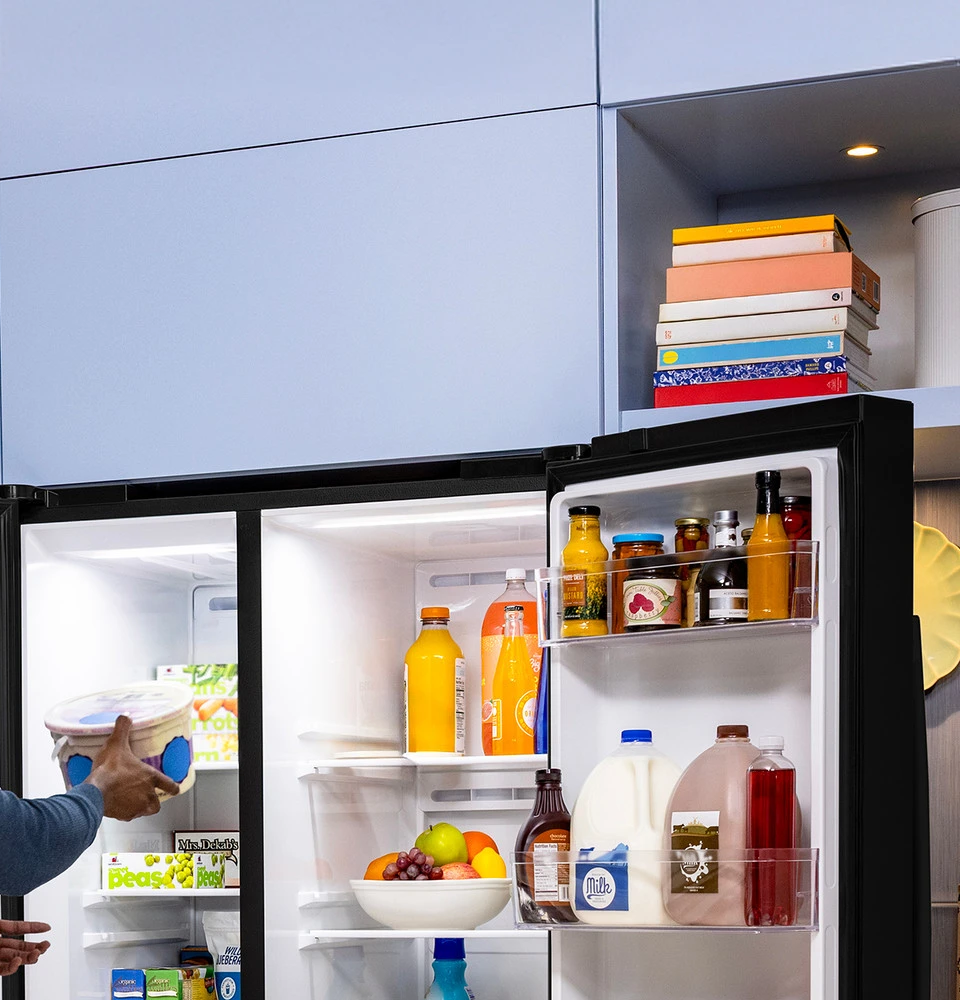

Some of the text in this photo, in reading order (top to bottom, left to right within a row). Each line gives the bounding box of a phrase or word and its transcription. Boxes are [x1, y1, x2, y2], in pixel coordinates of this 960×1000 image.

[178, 839, 202, 851] Mrs.
[108, 870, 163, 889] peas
[586, 876, 612, 894] Milk
